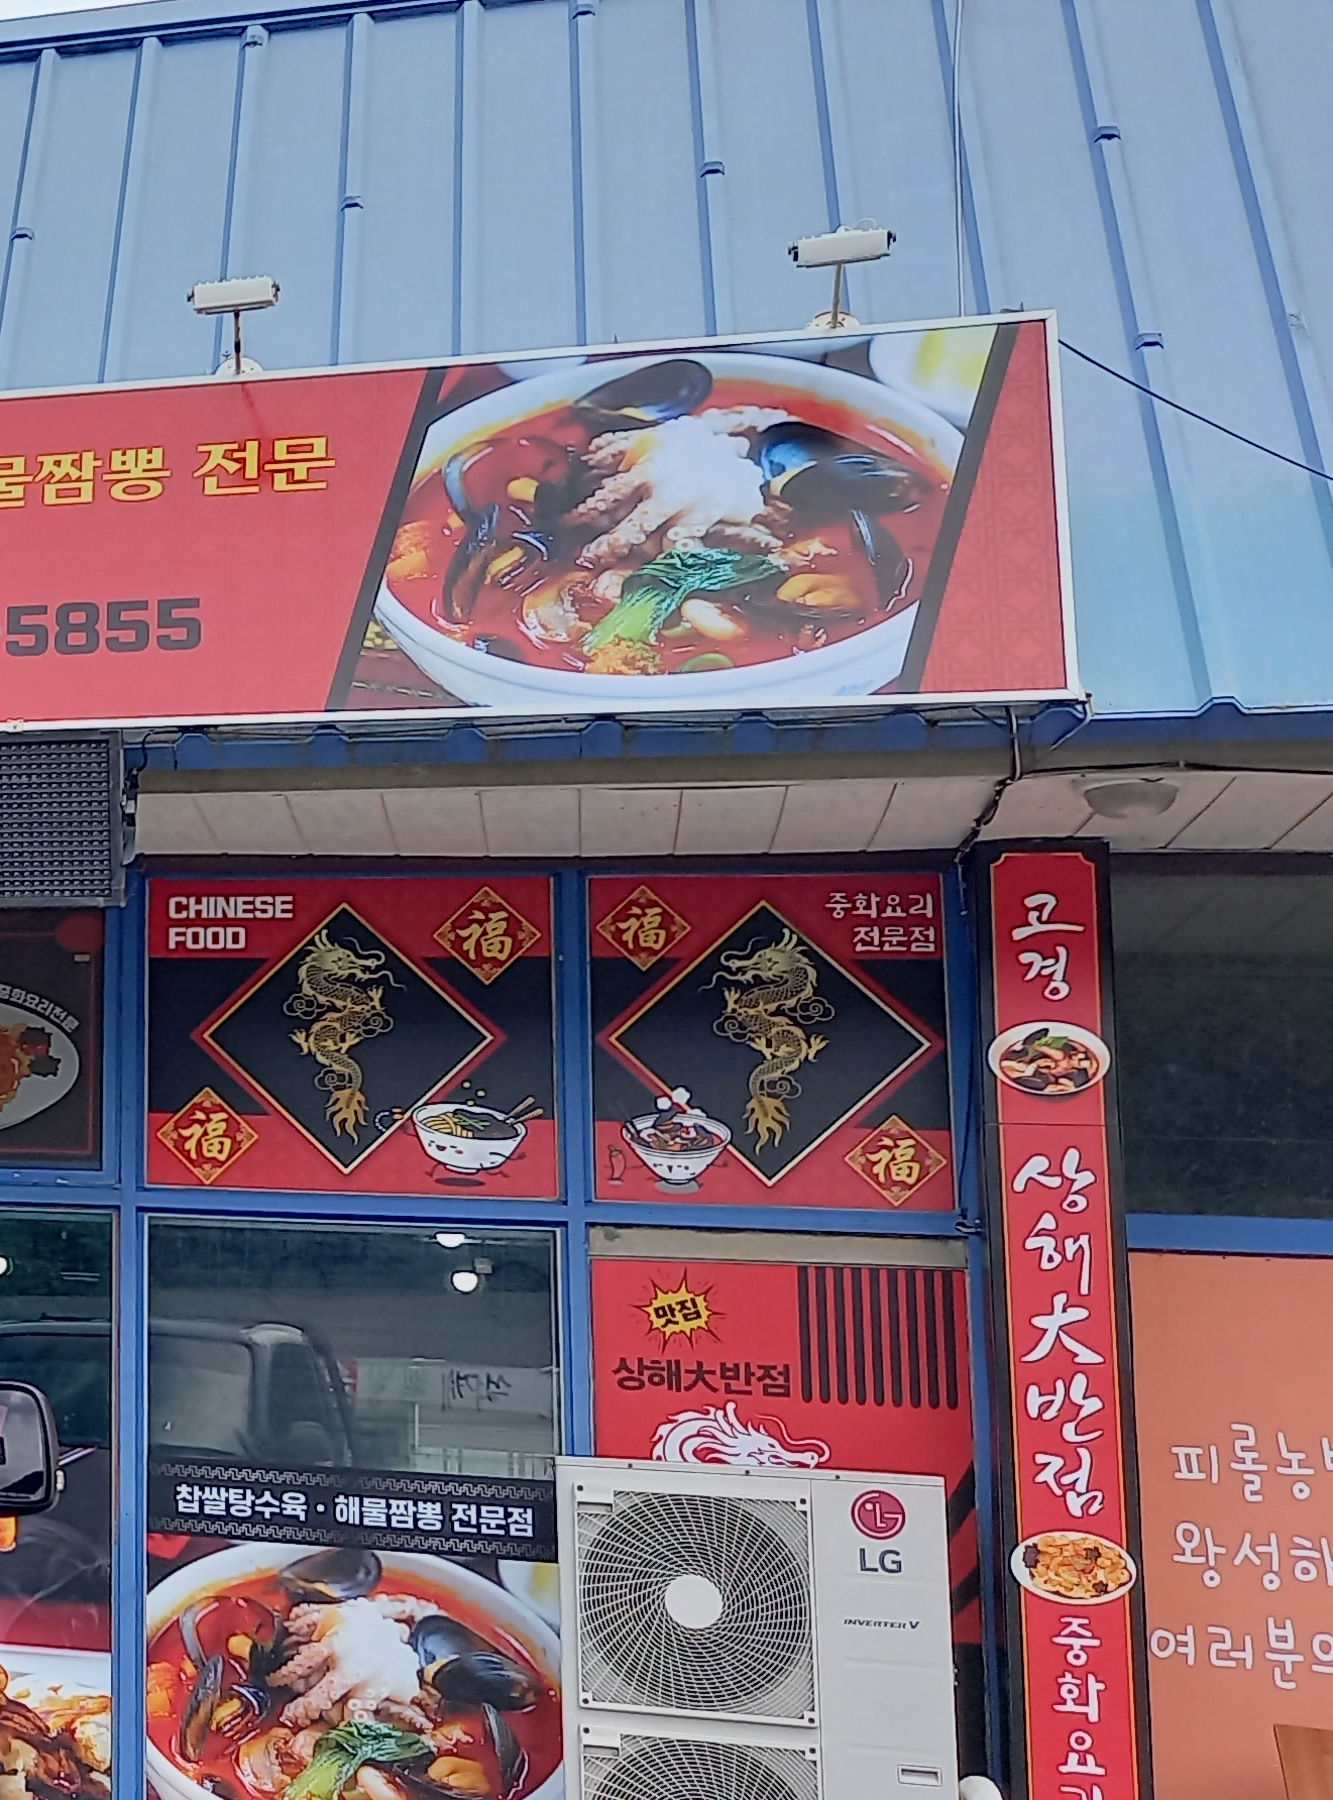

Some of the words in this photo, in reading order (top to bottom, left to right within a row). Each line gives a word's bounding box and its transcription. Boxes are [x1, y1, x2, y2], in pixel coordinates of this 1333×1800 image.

[193, 434, 337, 497] 전문
[167, 896, 295, 920] CHINESE
[824, 892, 934, 919] 중화요리
[167, 926, 247, 950] FOOD
[457, 910, 513, 962] 福
[616, 905, 668, 951] 福
[852, 925, 936, 953] 전문점
[1011, 892, 1086, 1001] 고경
[179, 1110, 233, 1163] 福
[868, 1136, 921, 1185] 福
[651, 1296, 702, 1328] 맛집
[174, 1482, 308, 1522] 찹쌀탕수육
[334, 1495, 443, 1532] 해물짬뽕
[450, 1502, 535, 1537] 전문점
[859, 1547, 902, 1574] LG
[843, 1618, 907, 1630] INVERTER
